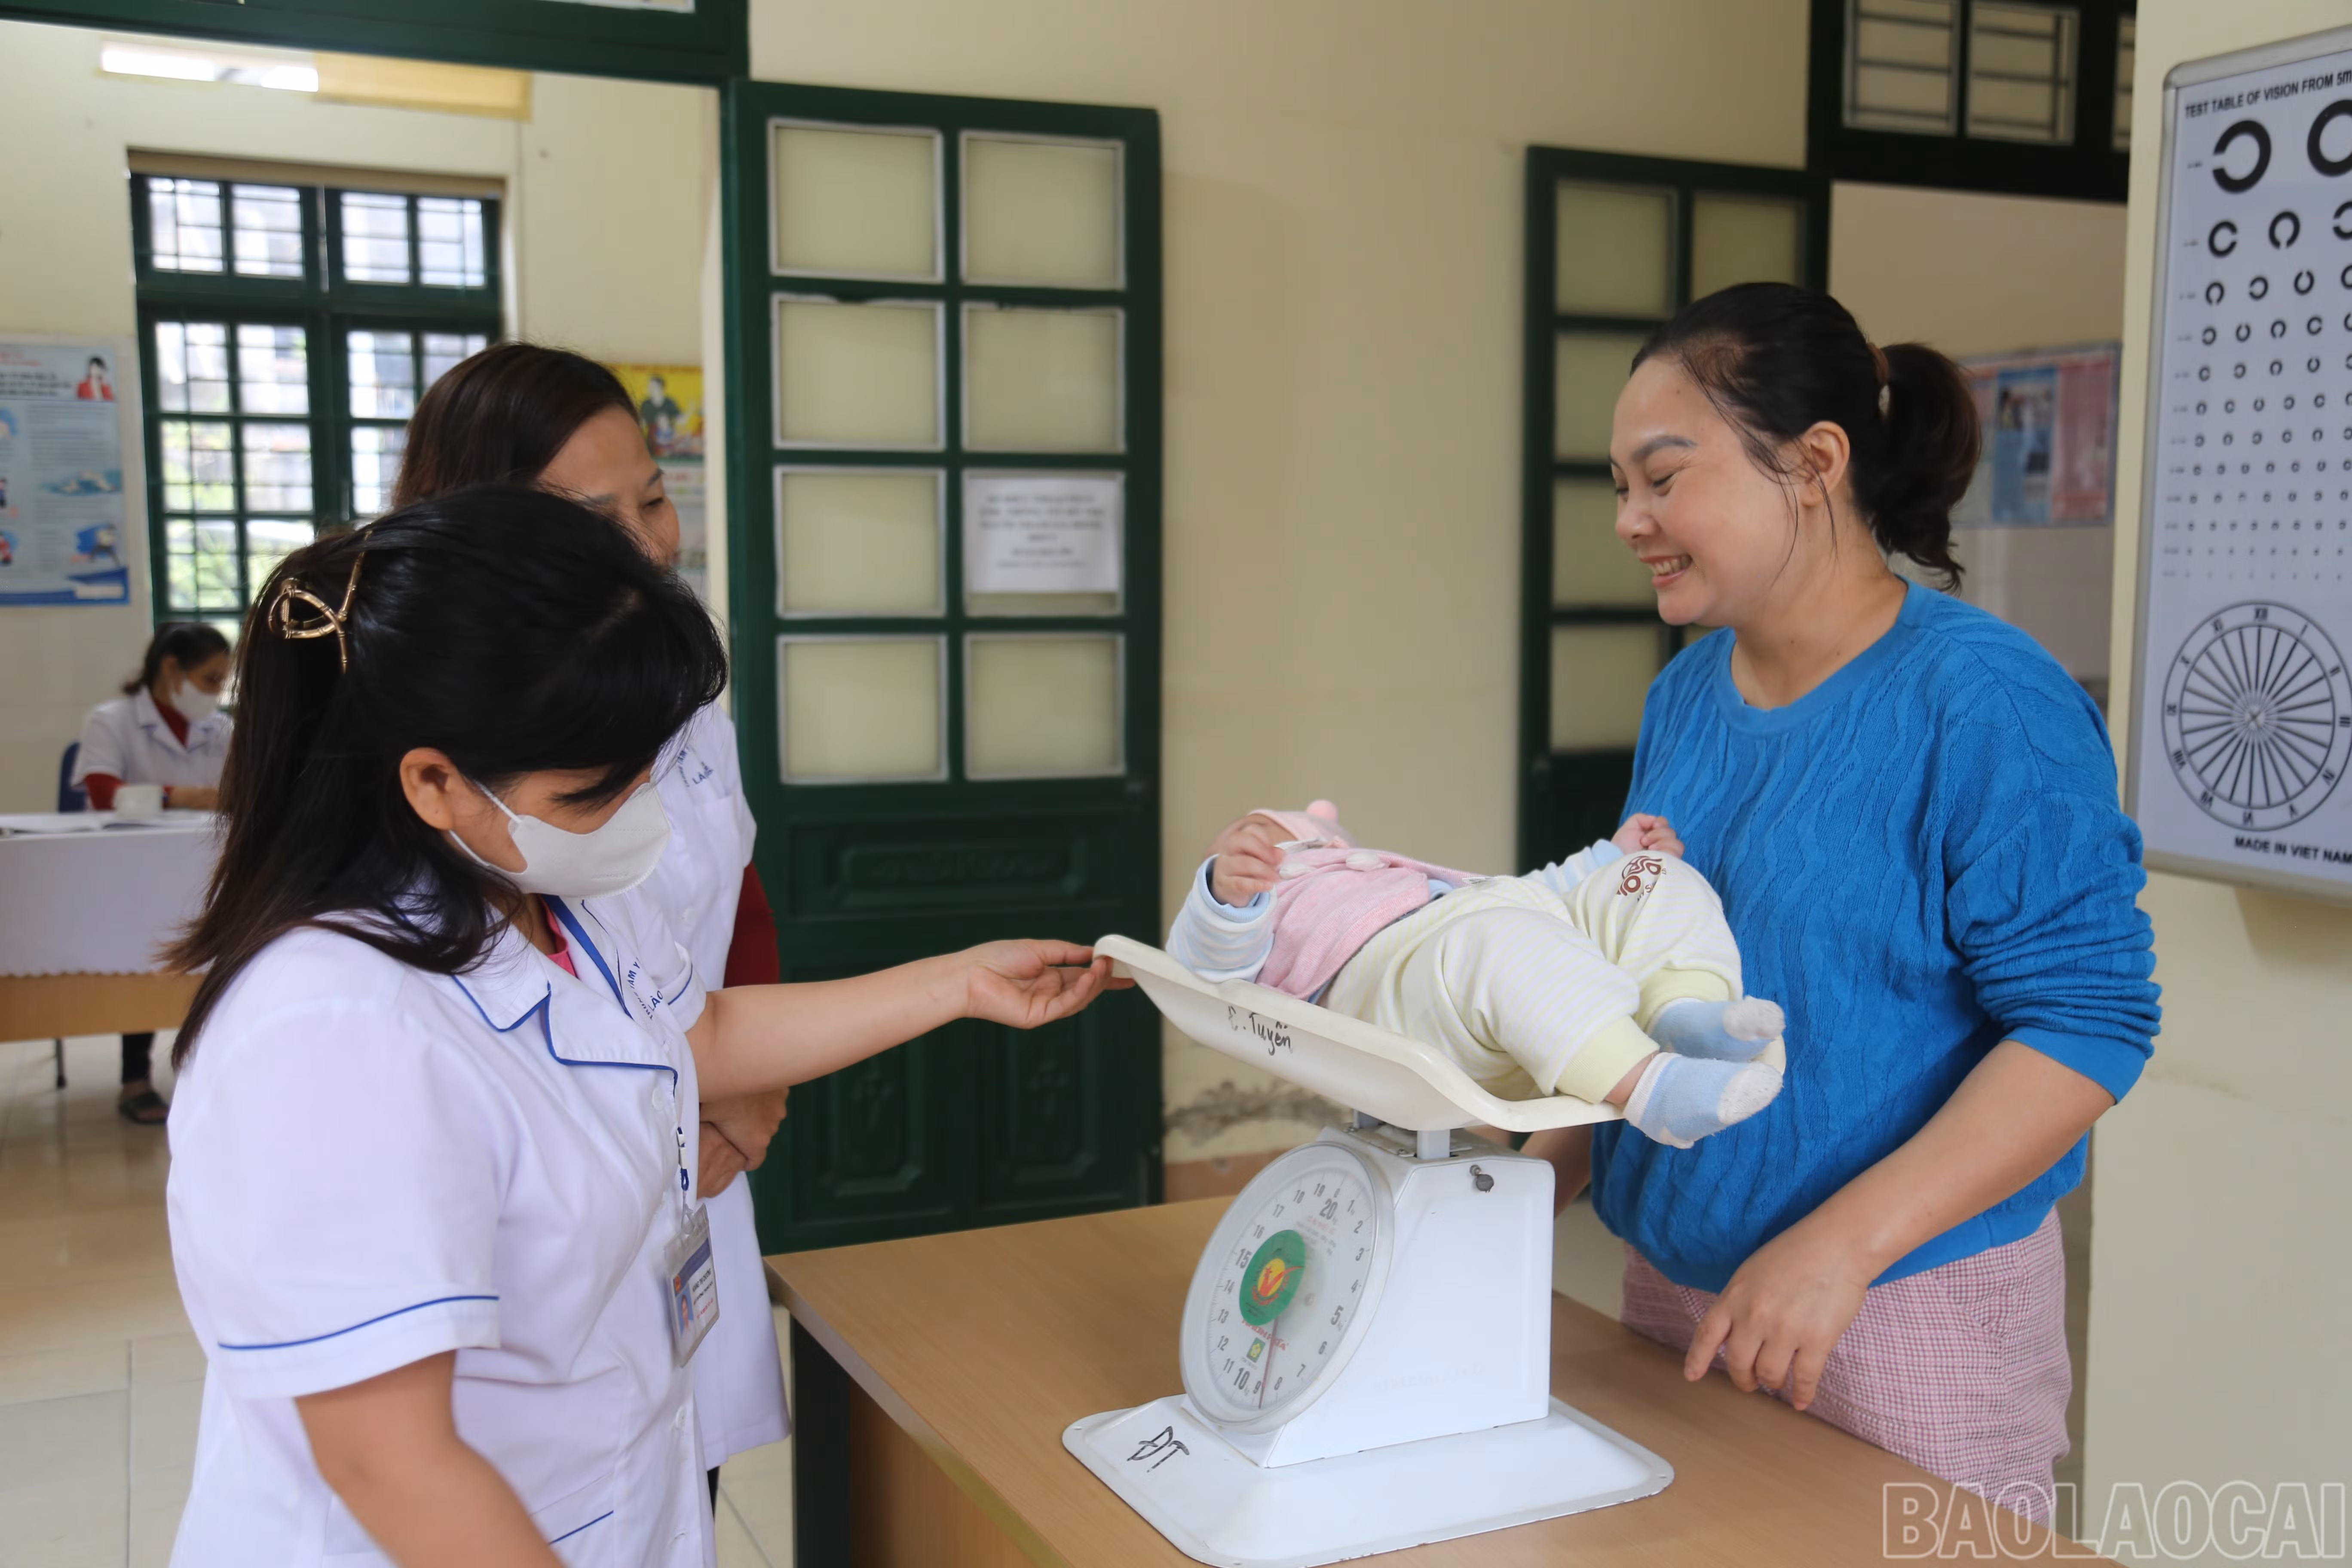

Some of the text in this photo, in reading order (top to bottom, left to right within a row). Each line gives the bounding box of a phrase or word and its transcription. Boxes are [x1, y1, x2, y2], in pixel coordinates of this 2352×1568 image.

[2185, 101, 2209, 118] TEST
[2212, 93, 2244, 114] TABLE
[2247, 90, 2261, 105] OF
[2264, 82, 2298, 101] VISION
[2302, 74, 2333, 94] FROM
[2235, 837, 2352, 865] MADE IN VIET NAM
[1293, 1189, 1305, 1204] 18
[1313, 1183, 1326, 1197] 19
[1272, 1204, 1285, 1218] 17
[1319, 1198, 1338, 1220] 20
[1253, 1225, 1265, 1239] 16
[1354, 1220, 1363, 1234] 2
[1235, 1248, 1252, 1268] 15
[1356, 1247, 1364, 1261] 3
[1224, 1279, 1235, 1294] 14
[1351, 1279, 1359, 1293] 4
[1217, 1308, 1229, 1323] 13
[1331, 1305, 1344, 1325] 5
[1217, 1335, 1229, 1351] 12
[1318, 1341, 1327, 1355] 6
[1224, 1358, 1234, 1373] 11
[1296, 1363, 1306, 1377] 7
[1234, 1367, 1250, 1390] 10
[1274, 1376, 1283, 1390] 8
[1253, 1380, 1262, 1394] 9
